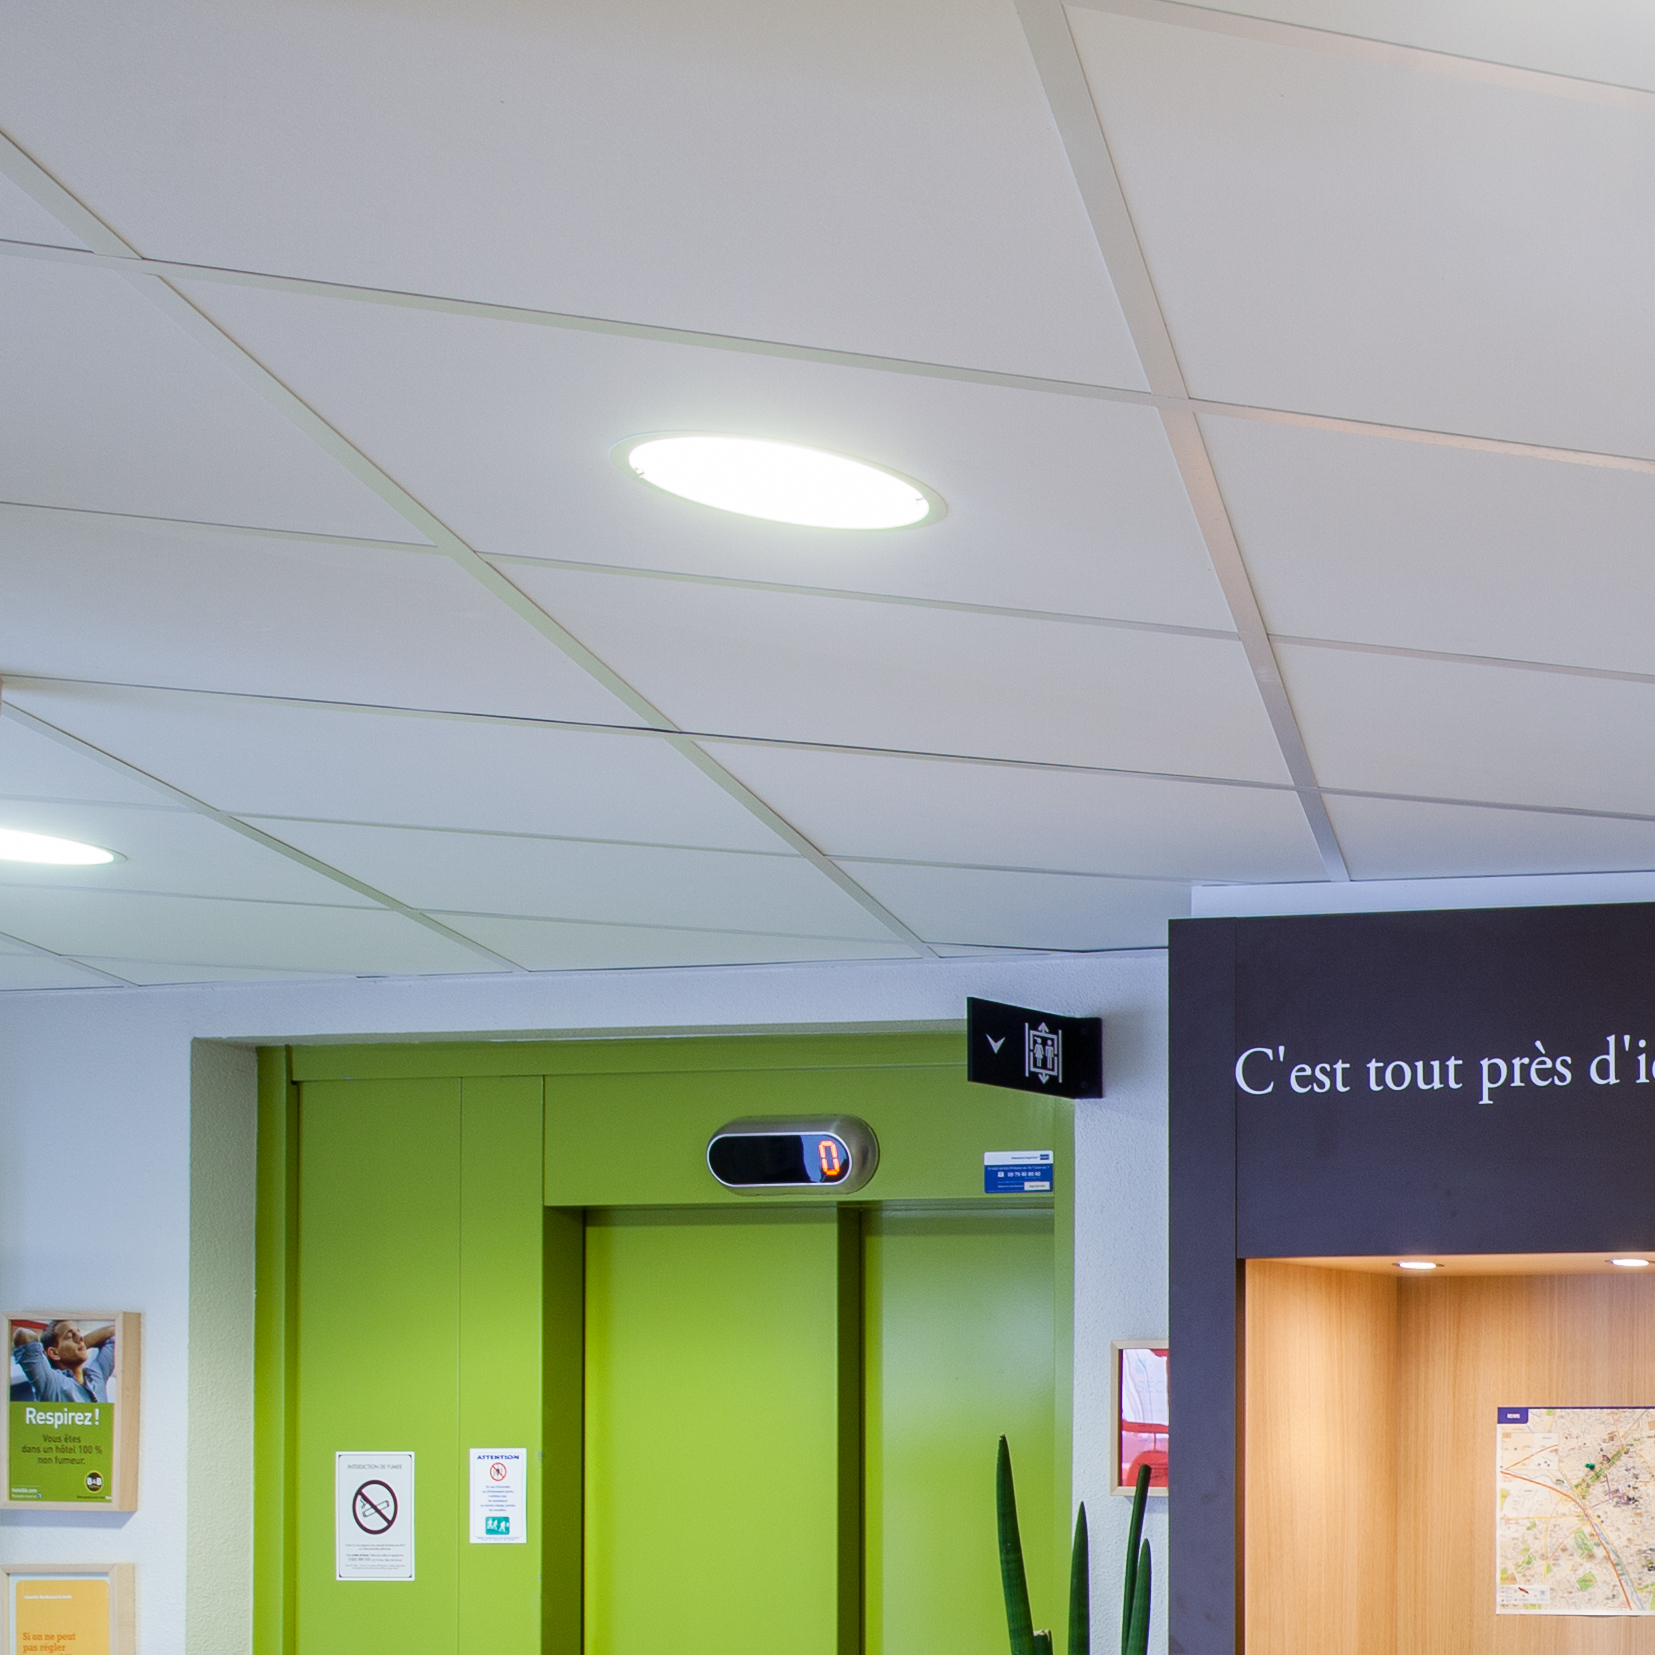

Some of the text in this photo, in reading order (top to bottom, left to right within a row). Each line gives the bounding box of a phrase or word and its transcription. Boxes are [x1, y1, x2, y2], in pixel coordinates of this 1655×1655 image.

[1235, 1045, 1350, 1095] C'est
[1367, 1055, 1463, 1091] tout
[1479, 1040, 1573, 1105] près
[819, 1140, 840, 1176] 0
[42, 1433, 82, 1443] Vous êtes
[21, 1445, 41, 1454] dans
[55, 1444, 76, 1454] hôtel
[79, 1445, 93, 1455] 100
[22, 1632, 31, 1641] Si
[56, 1633, 76, 1643] peut
[22, 1643, 66, 1654] pas régler
